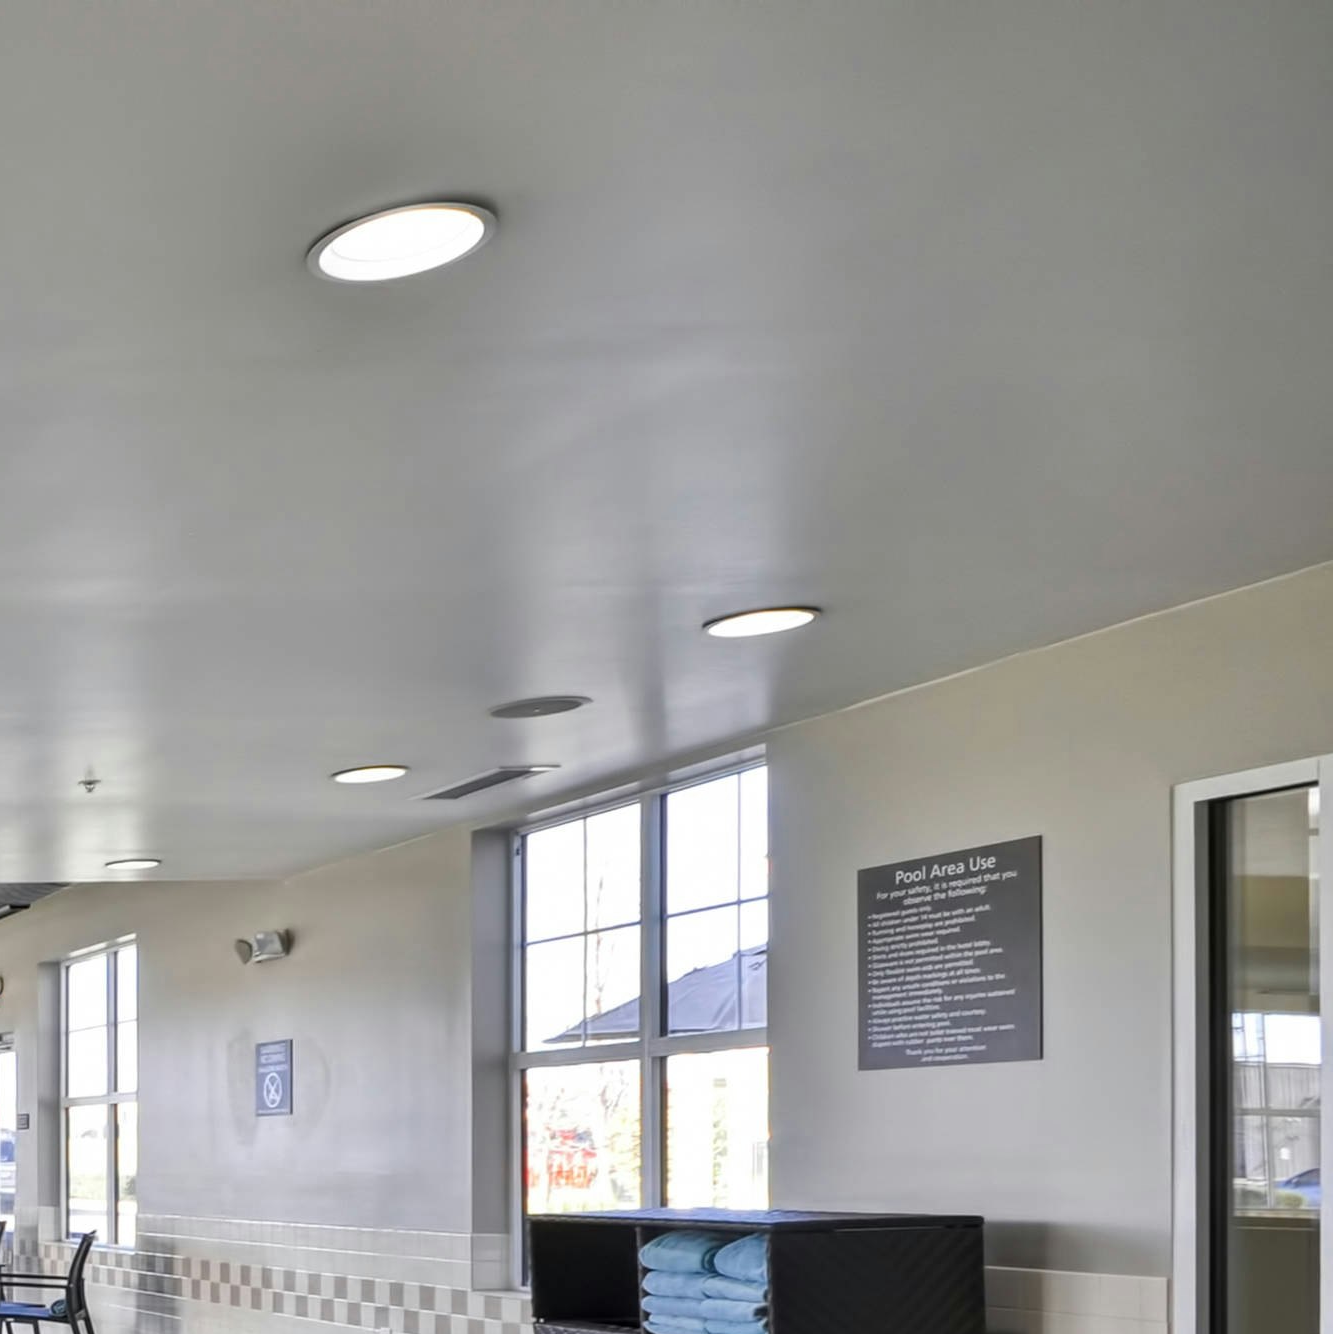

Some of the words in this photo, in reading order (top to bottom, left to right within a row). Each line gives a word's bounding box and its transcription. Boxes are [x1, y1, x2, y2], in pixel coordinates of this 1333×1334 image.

[895, 866, 927, 885] Pool
[930, 861, 964, 880] Area
[969, 855, 997, 872] Use
